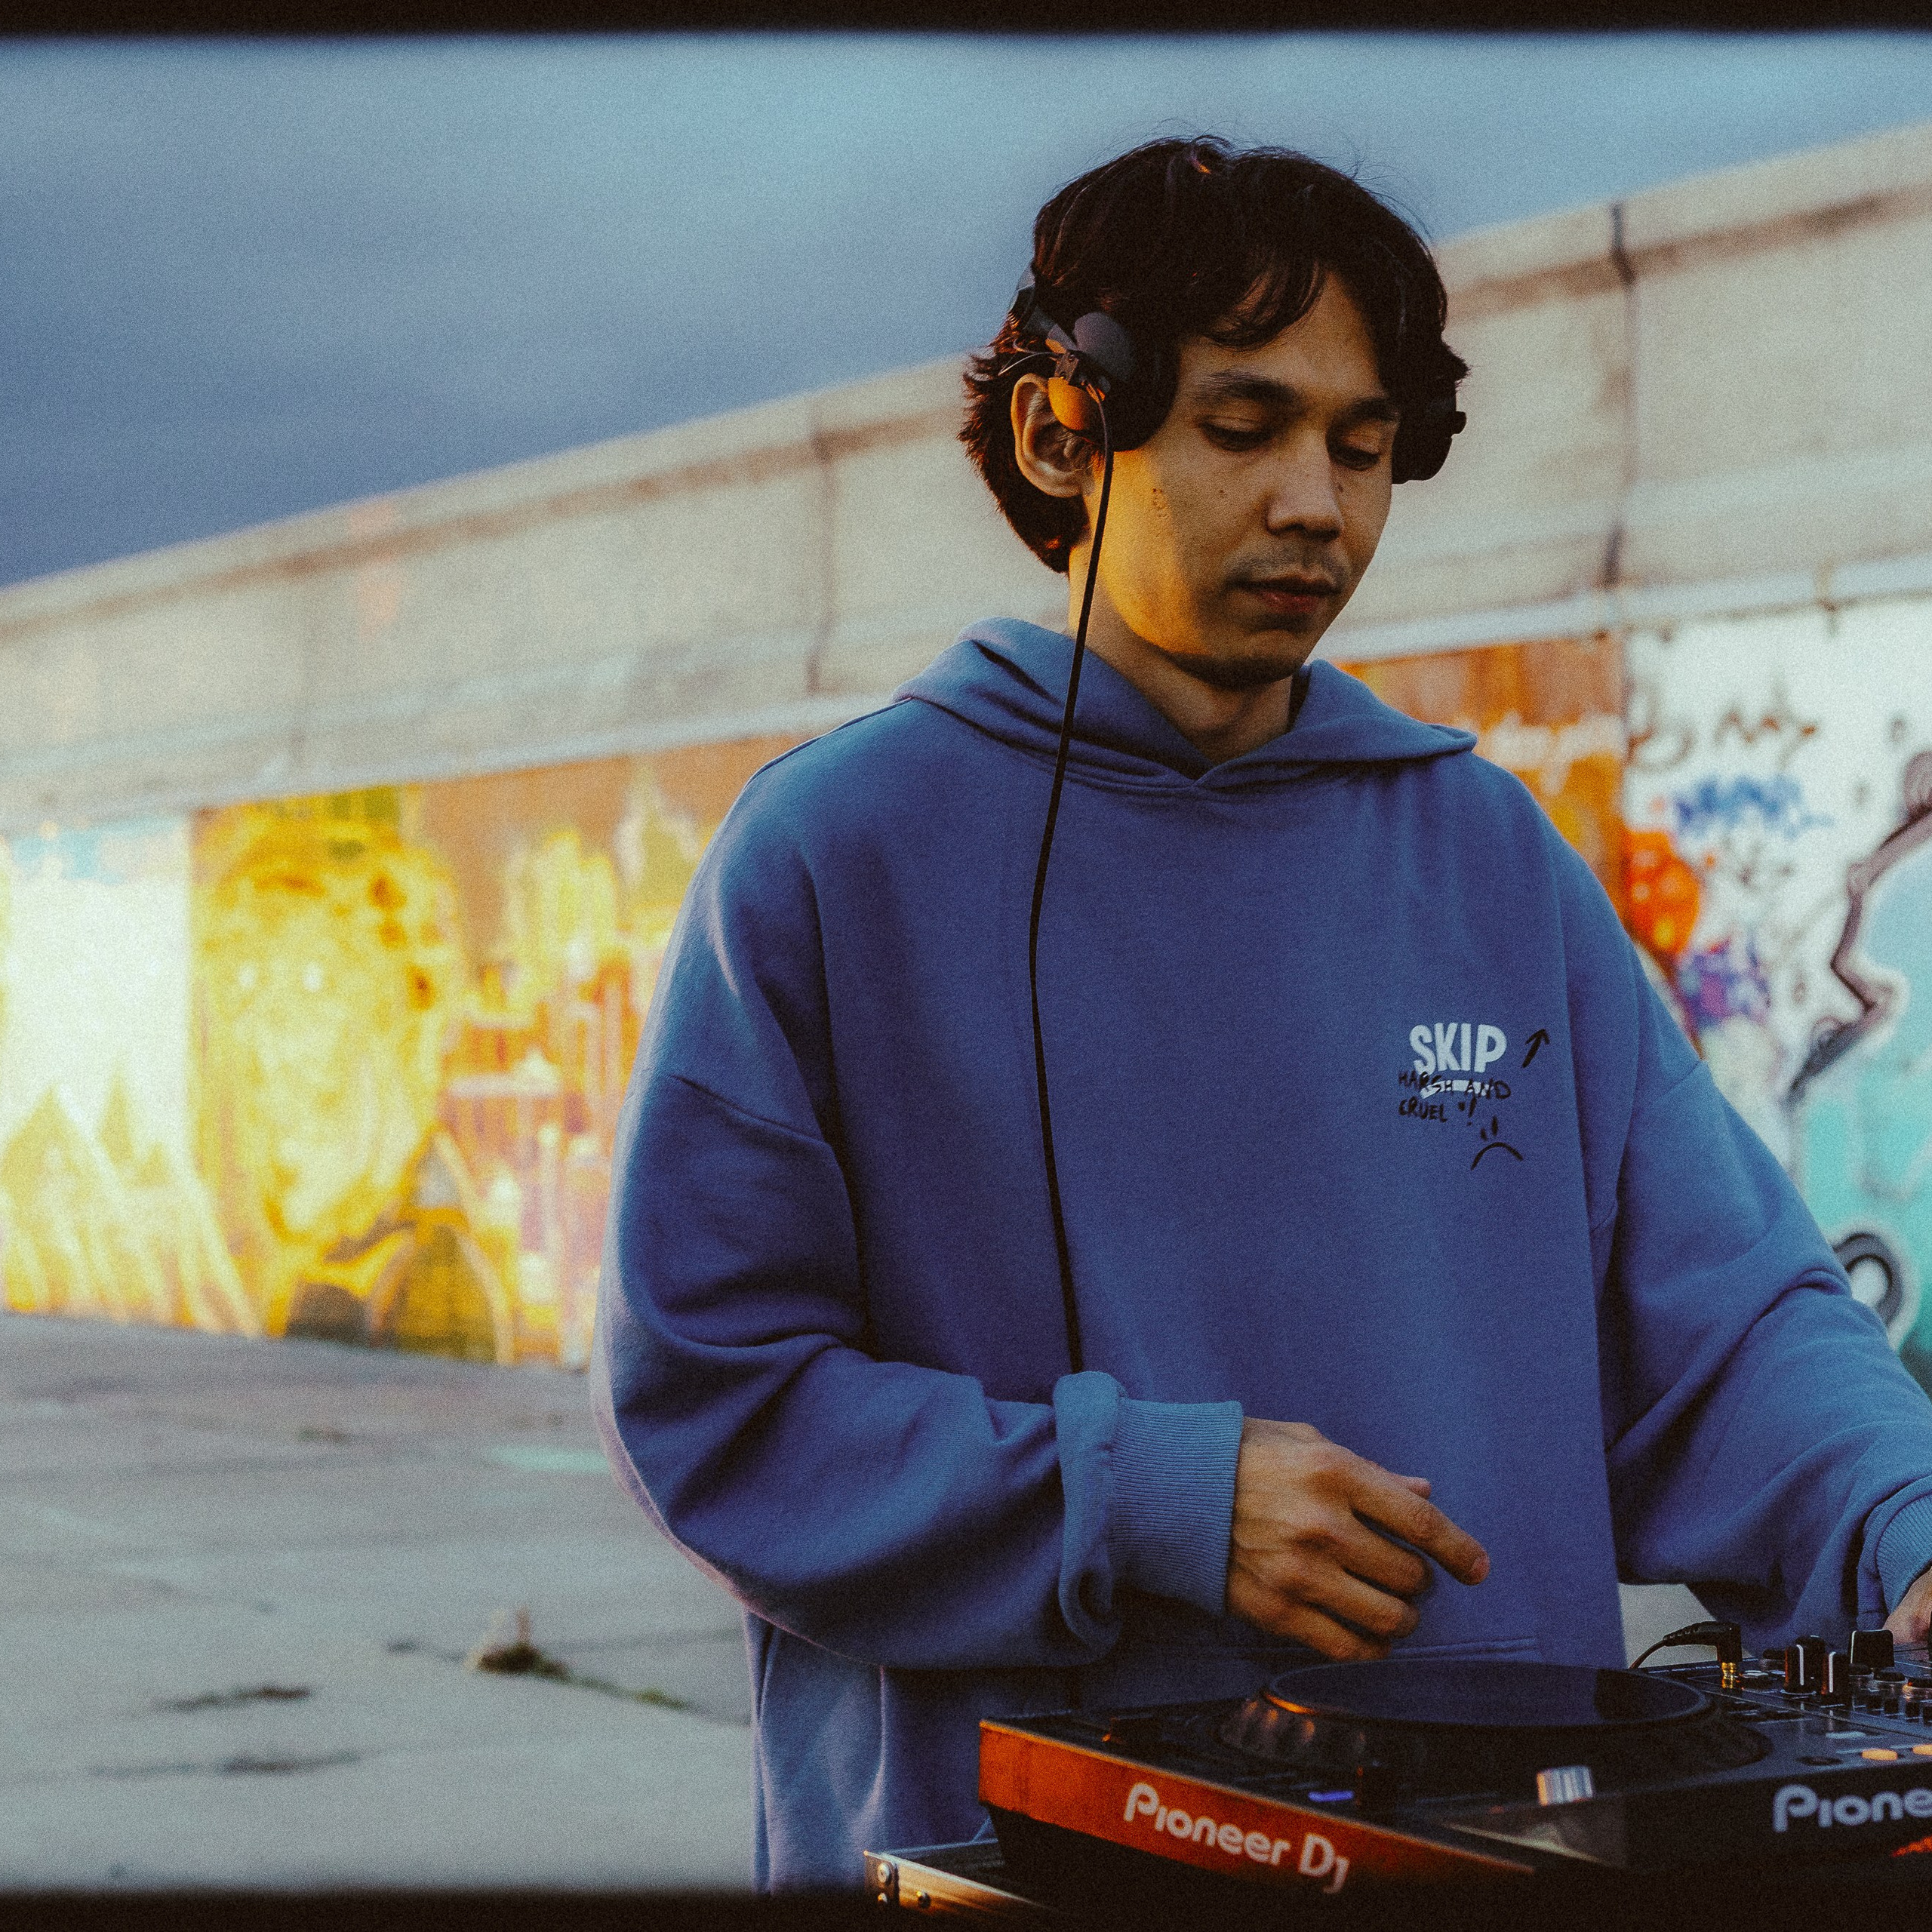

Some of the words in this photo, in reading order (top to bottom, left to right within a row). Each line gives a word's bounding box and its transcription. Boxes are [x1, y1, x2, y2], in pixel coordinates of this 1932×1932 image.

[1409, 1022, 1507, 1075] SKIP
[1464, 1077, 1512, 1100] AND
[1398, 1096, 1447, 1123] CRUEL
[1124, 1782, 1291, 1866] Pioneer
